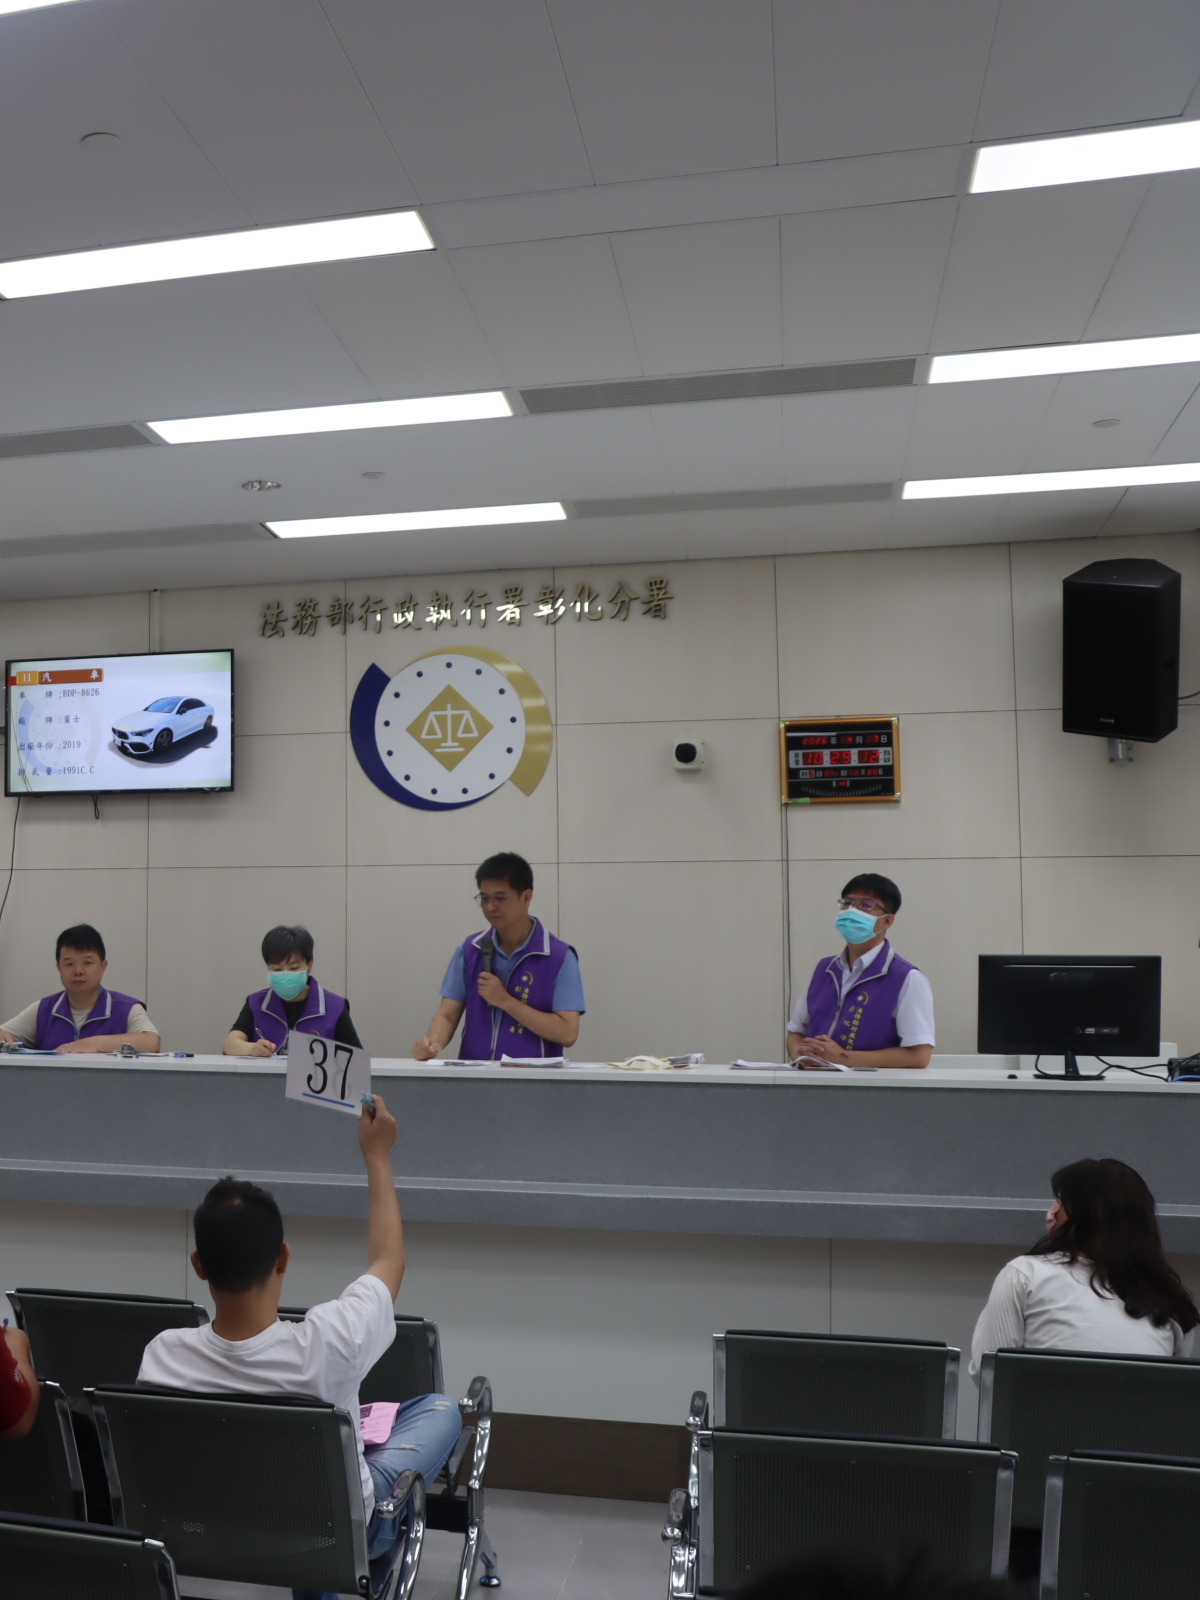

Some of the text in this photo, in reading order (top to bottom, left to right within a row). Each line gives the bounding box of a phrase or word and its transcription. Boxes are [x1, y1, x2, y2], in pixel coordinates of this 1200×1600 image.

[258, 577, 675, 638] 法務部行政執行署彰化分署
[22, 673, 32, 682] 11
[307, 1038, 353, 1100] 37
